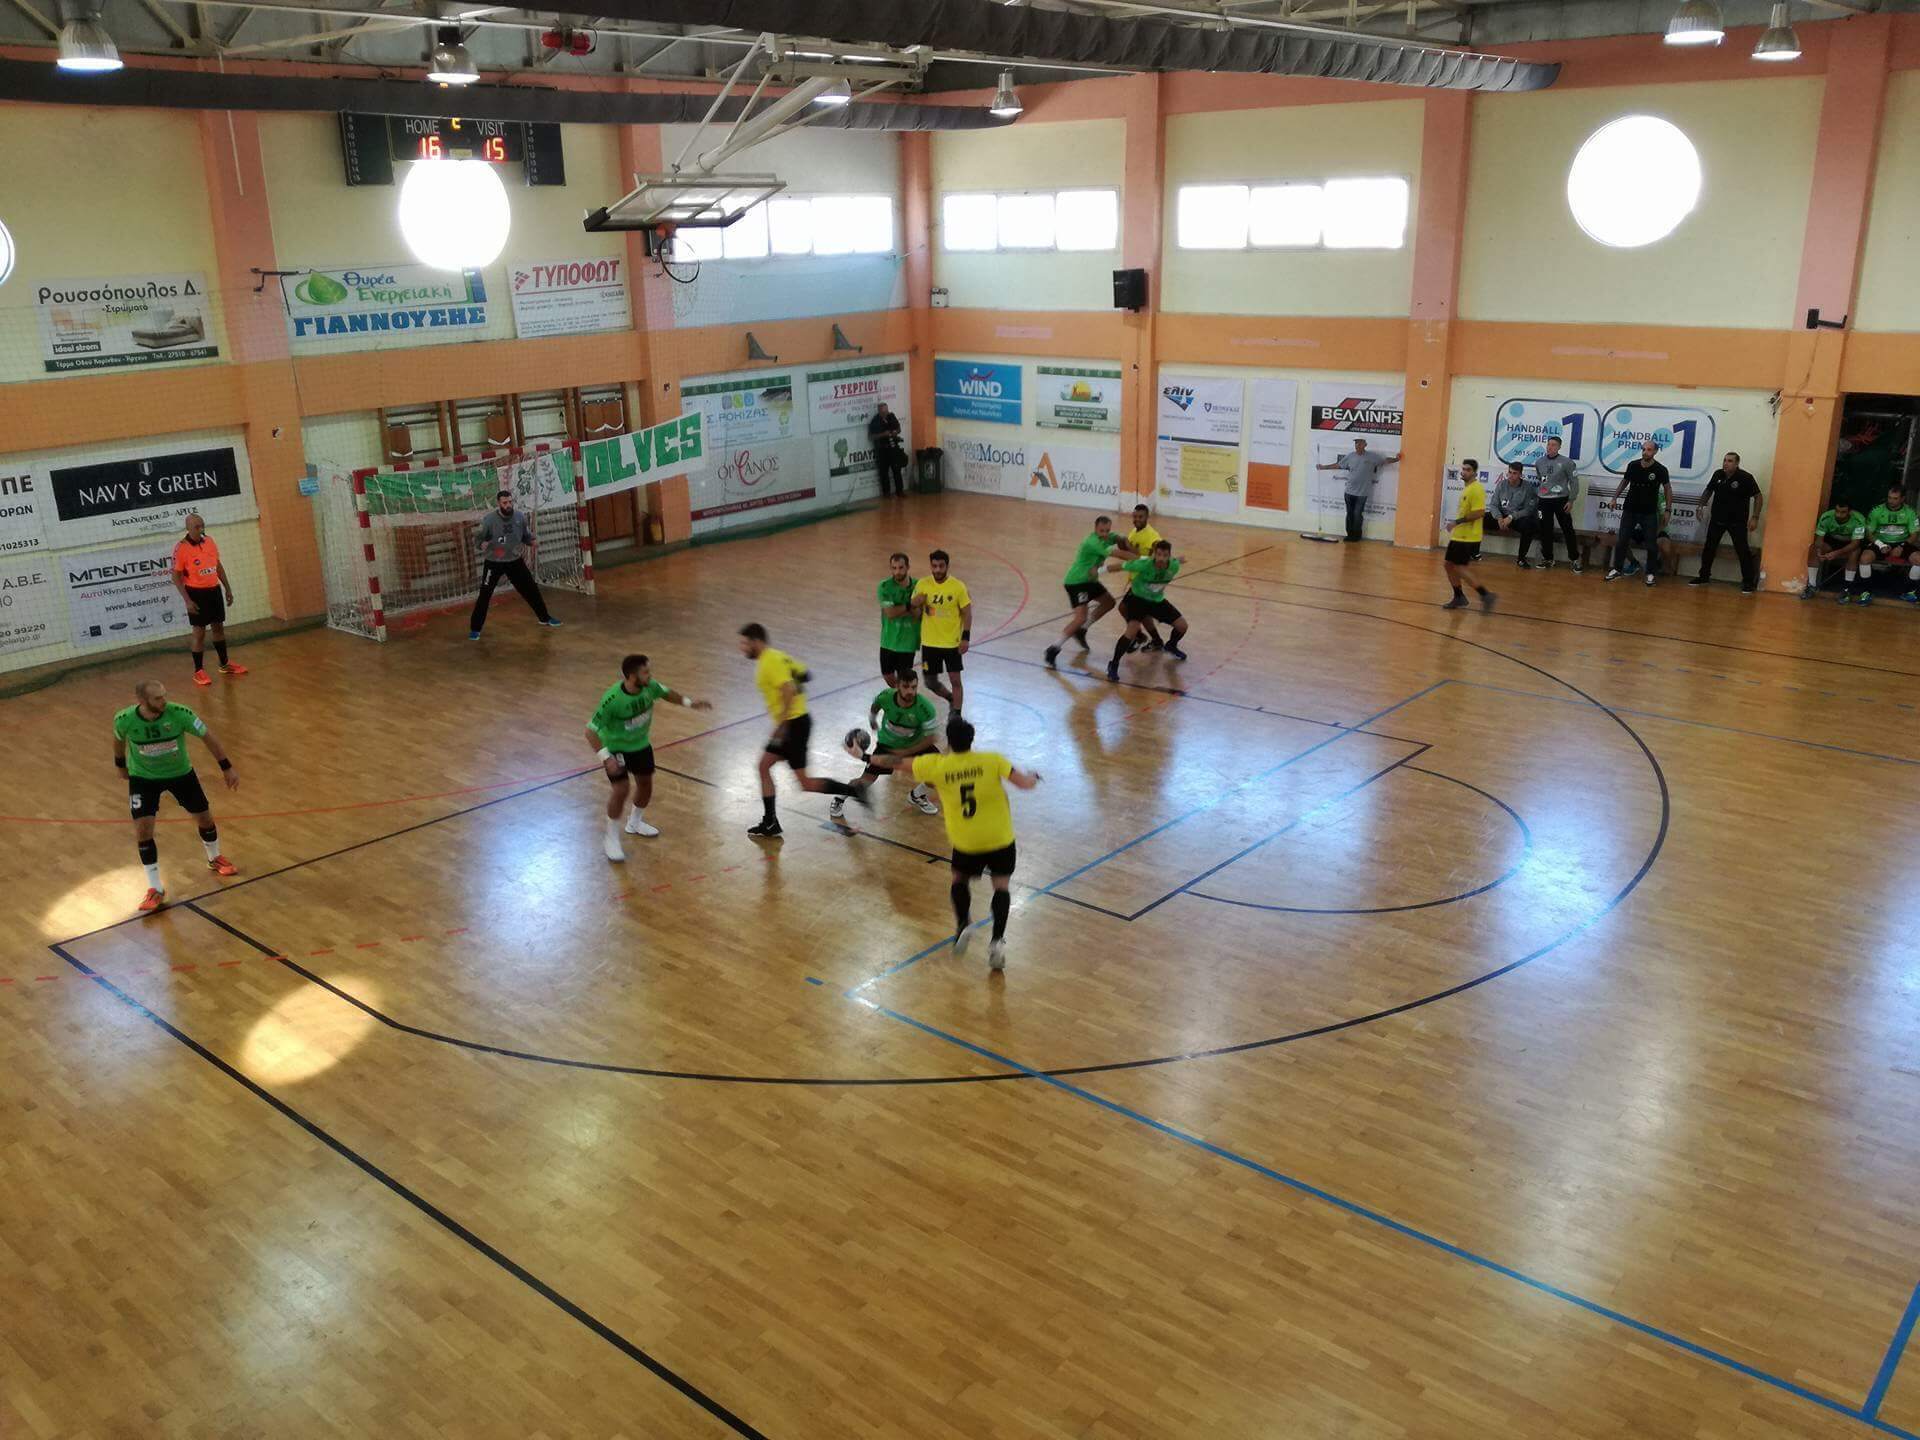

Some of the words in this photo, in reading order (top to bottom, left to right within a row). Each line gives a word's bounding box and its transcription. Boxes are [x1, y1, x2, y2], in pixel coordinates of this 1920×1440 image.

[405, 118, 440, 135] HOME
[420, 136, 442, 160] 16
[484, 137, 505, 161] 15
[343, 271, 396, 287] Θυρέα
[532, 260, 620, 289] ΤΥΠΟΦΩΤ
[38, 281, 178, 304] Ρουσσόπουλος
[293, 306, 487, 337] ΓΙΑΝΝΟΥΣΗΣ
[959, 378, 1003, 397] WIND
[1321, 407, 1403, 424] ΒΕΛΛΙΝΗΣ
[1506, 423, 1560, 436] HANDBALL
[1613, 430, 1671, 443] HANDBALL
[78, 483, 131, 506] NAVY
[139, 481, 152, 496] &
[158, 470, 218, 494] GREEN
[14, 623, 46, 635] 99220
[959, 783, 976, 818] 5
